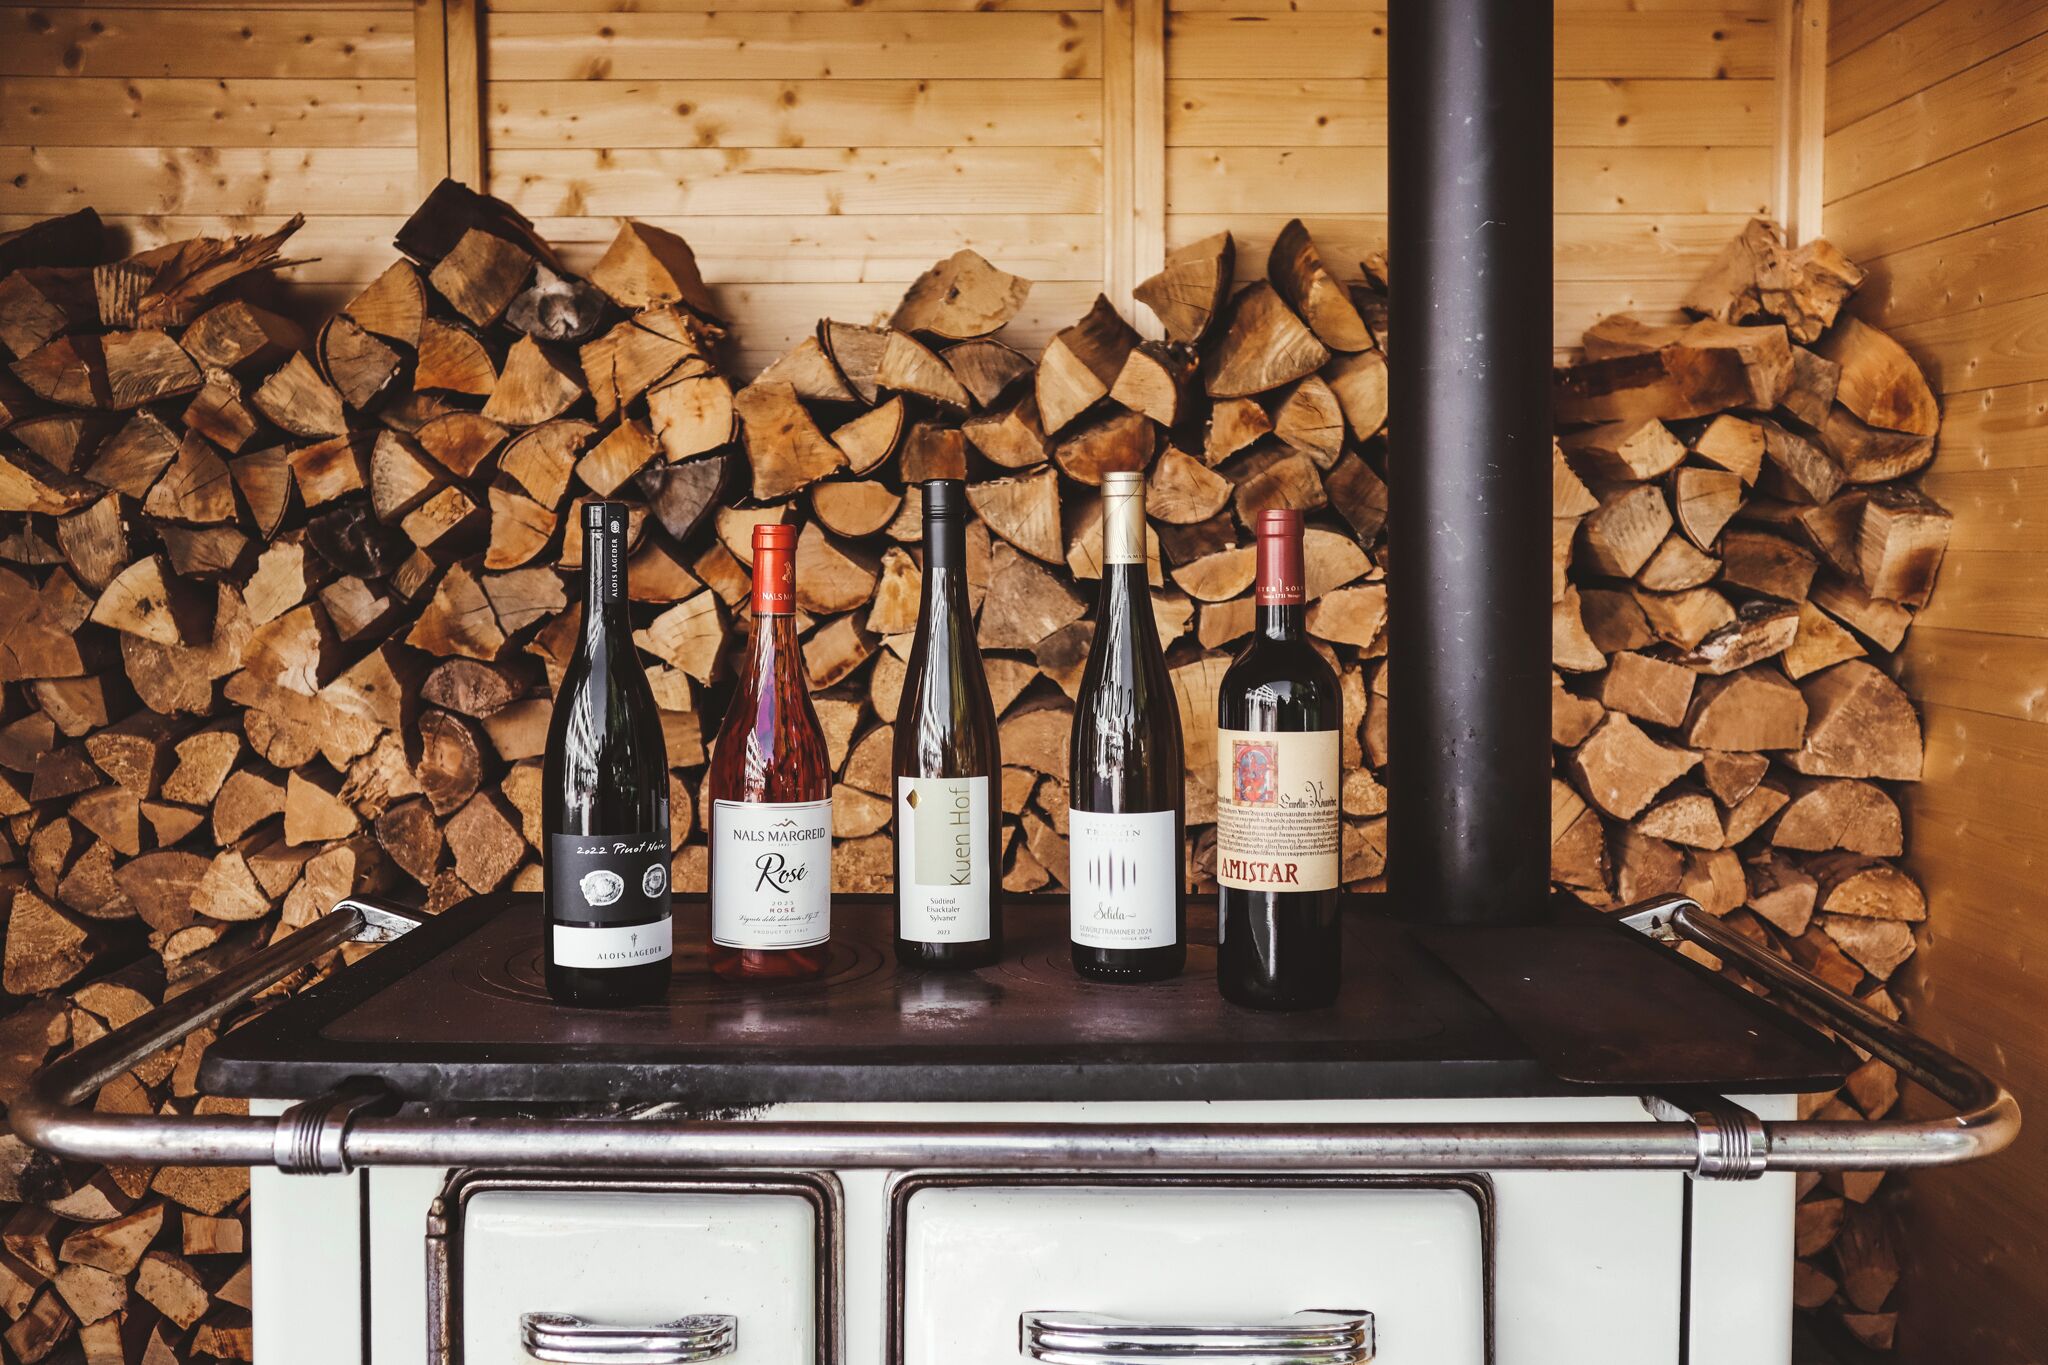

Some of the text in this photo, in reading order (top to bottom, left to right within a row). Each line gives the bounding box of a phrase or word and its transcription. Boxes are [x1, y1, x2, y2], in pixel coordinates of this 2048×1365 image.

[762, 592, 783, 600] NALS
[733, 827, 826, 842] NALS MARGREID
[948, 786, 971, 886] Kuen Hof
[576, 846, 608, 855] 2022
[612, 841, 646, 855] Pinot
[755, 852, 809, 894] Rosé
[1221, 857, 1299, 885] AMISTAR
[926, 905, 960, 913] Eisacktaler
[929, 914, 957, 922] Sylvaner
[597, 945, 663, 960] ALOIS LAGEDER
